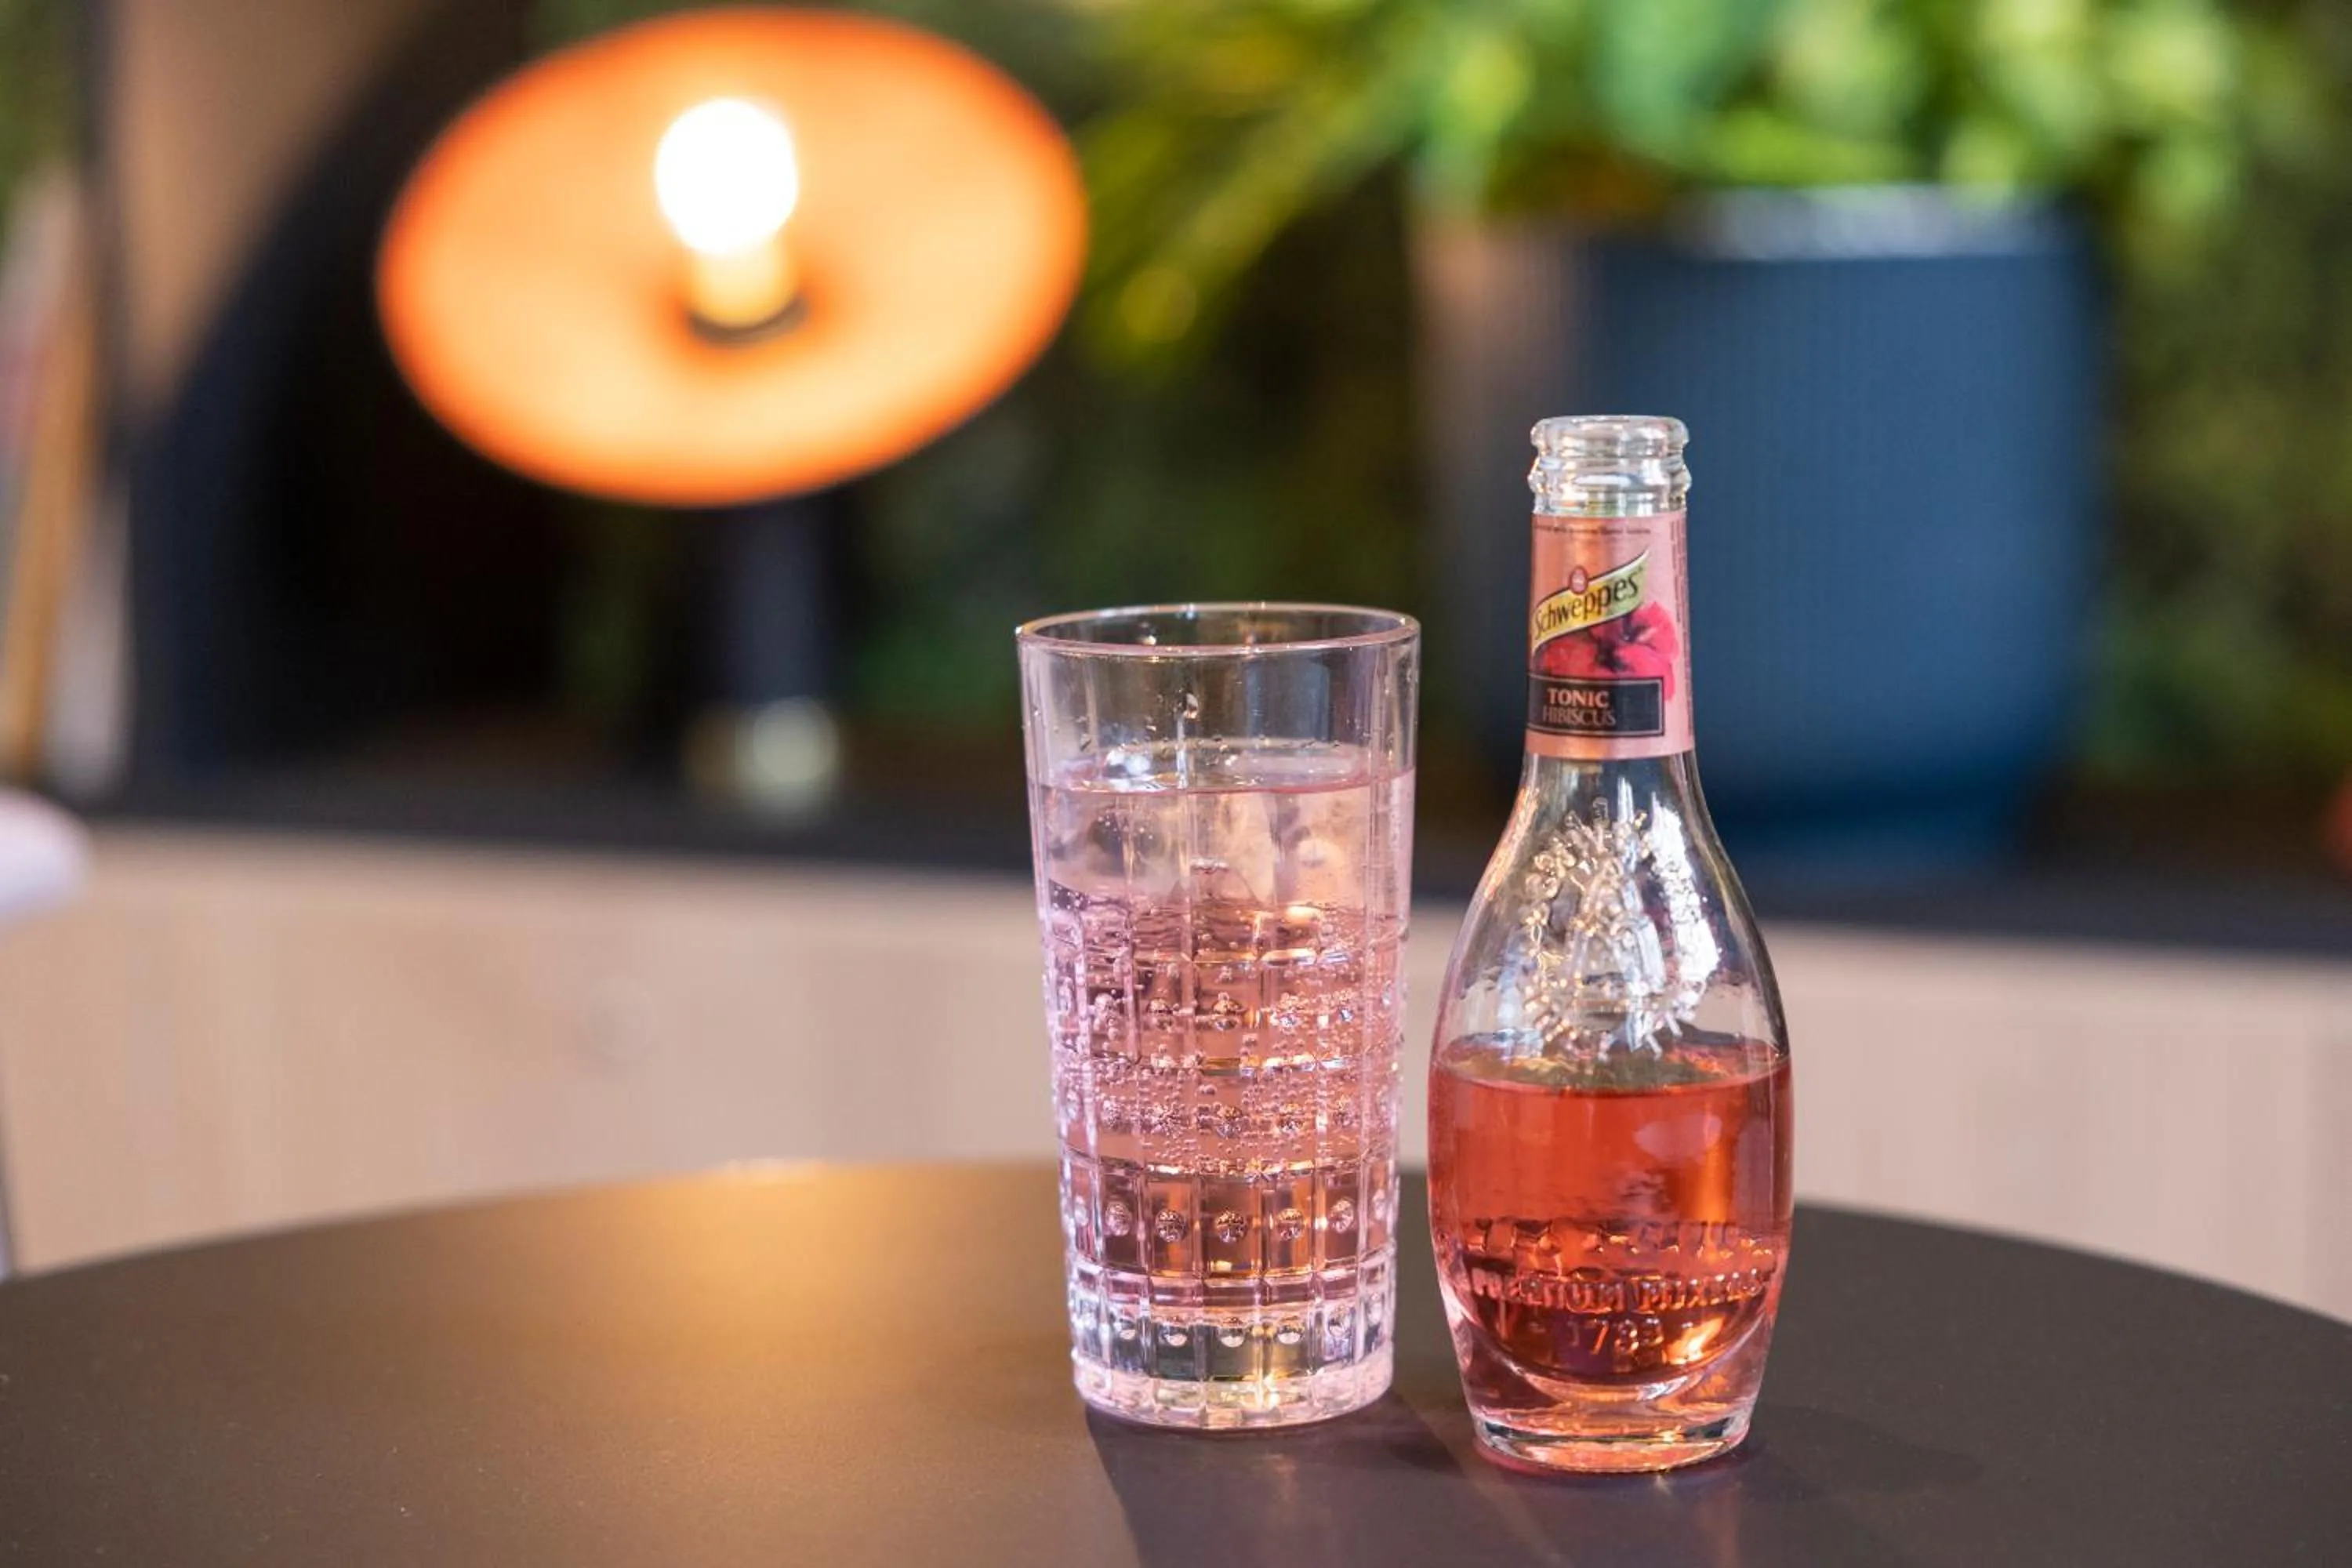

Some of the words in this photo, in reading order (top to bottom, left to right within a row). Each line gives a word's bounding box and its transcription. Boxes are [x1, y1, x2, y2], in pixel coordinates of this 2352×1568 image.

[1534, 572, 1639, 640] Schweppes
[1547, 687, 1610, 709] TONIC
[1542, 705, 1617, 726] HIBISCUS
